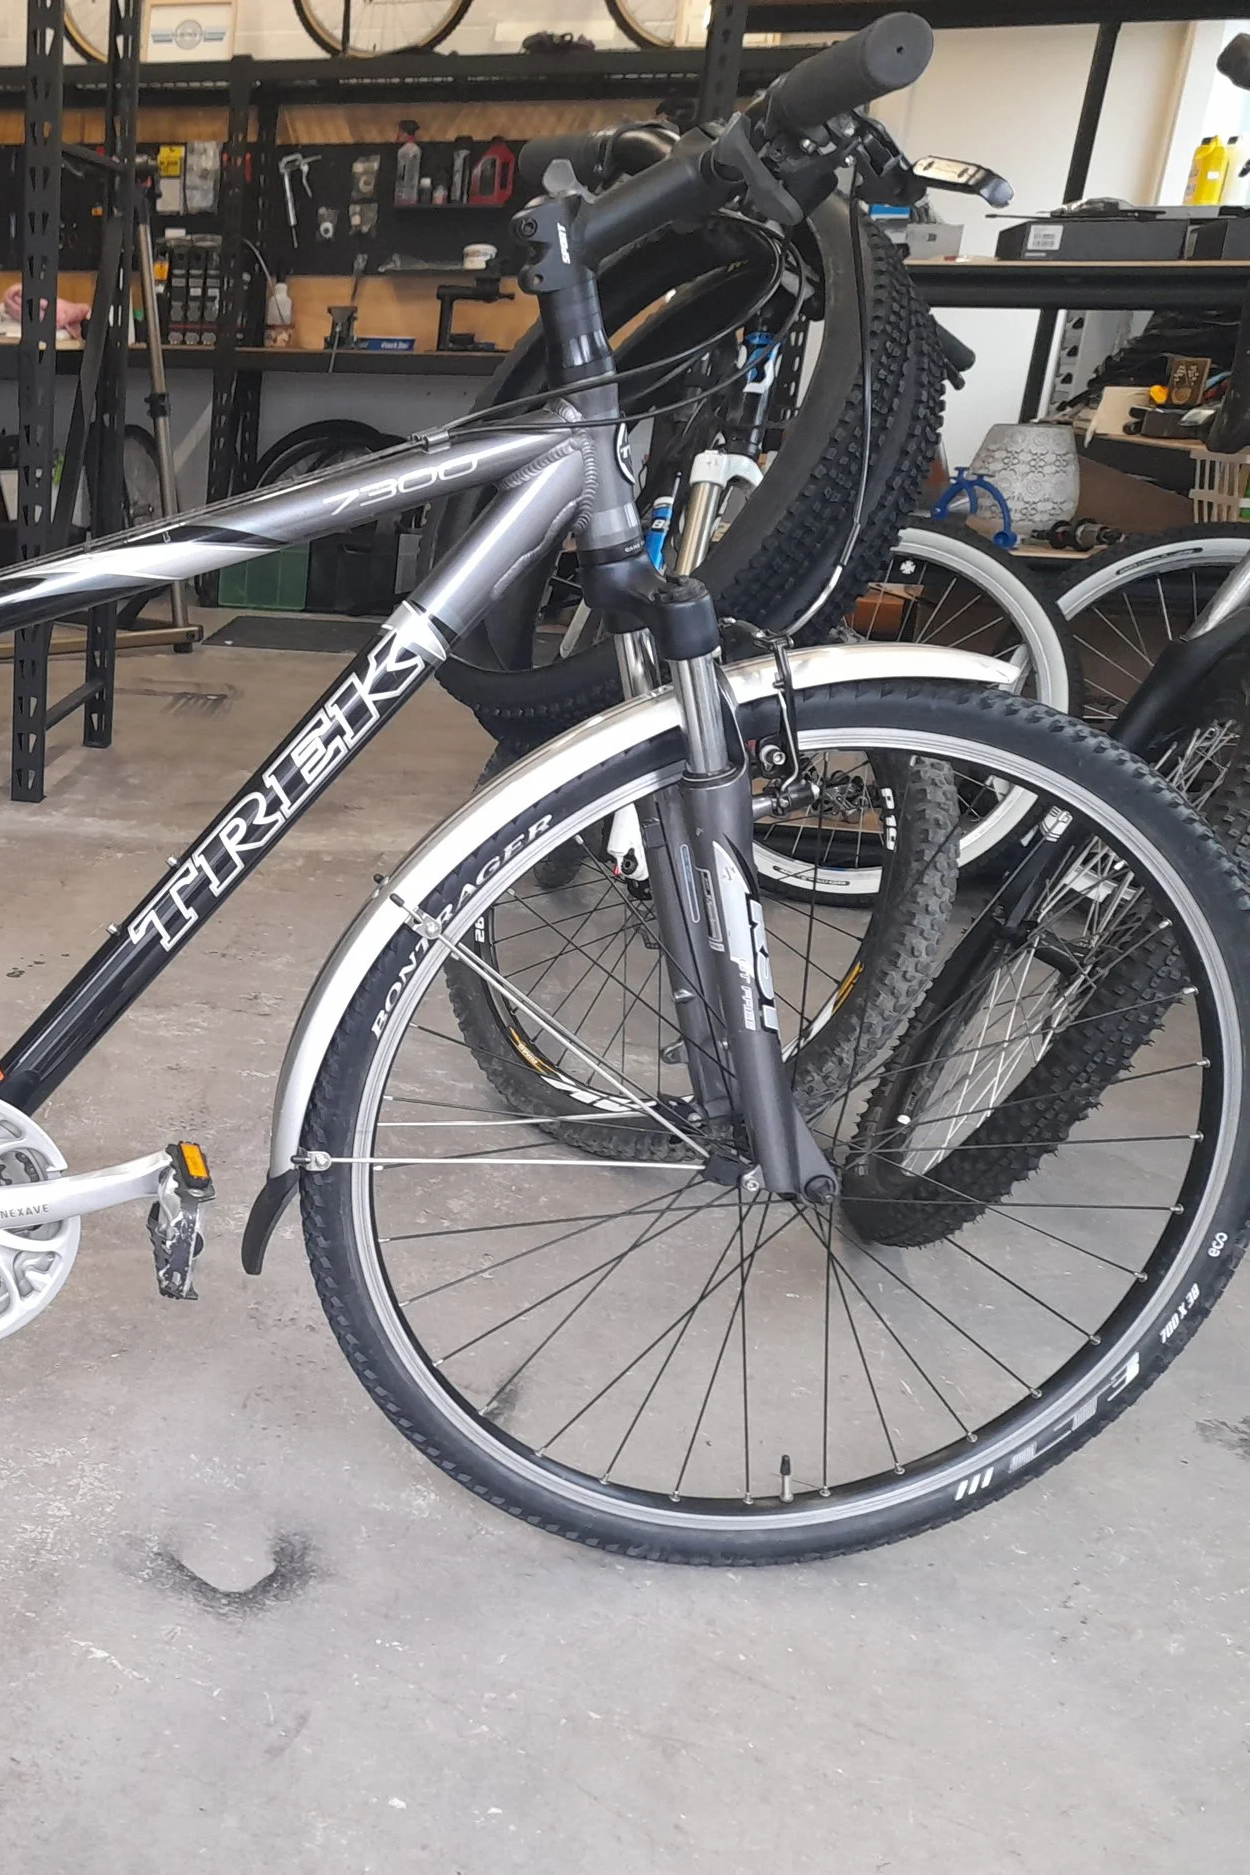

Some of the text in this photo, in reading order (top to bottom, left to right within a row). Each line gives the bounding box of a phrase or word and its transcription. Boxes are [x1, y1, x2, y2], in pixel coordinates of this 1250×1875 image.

[323, 453, 479, 516] 7300
[129, 623, 428, 951] TREK
[0, 1203, 50, 1219] NEXAVE
